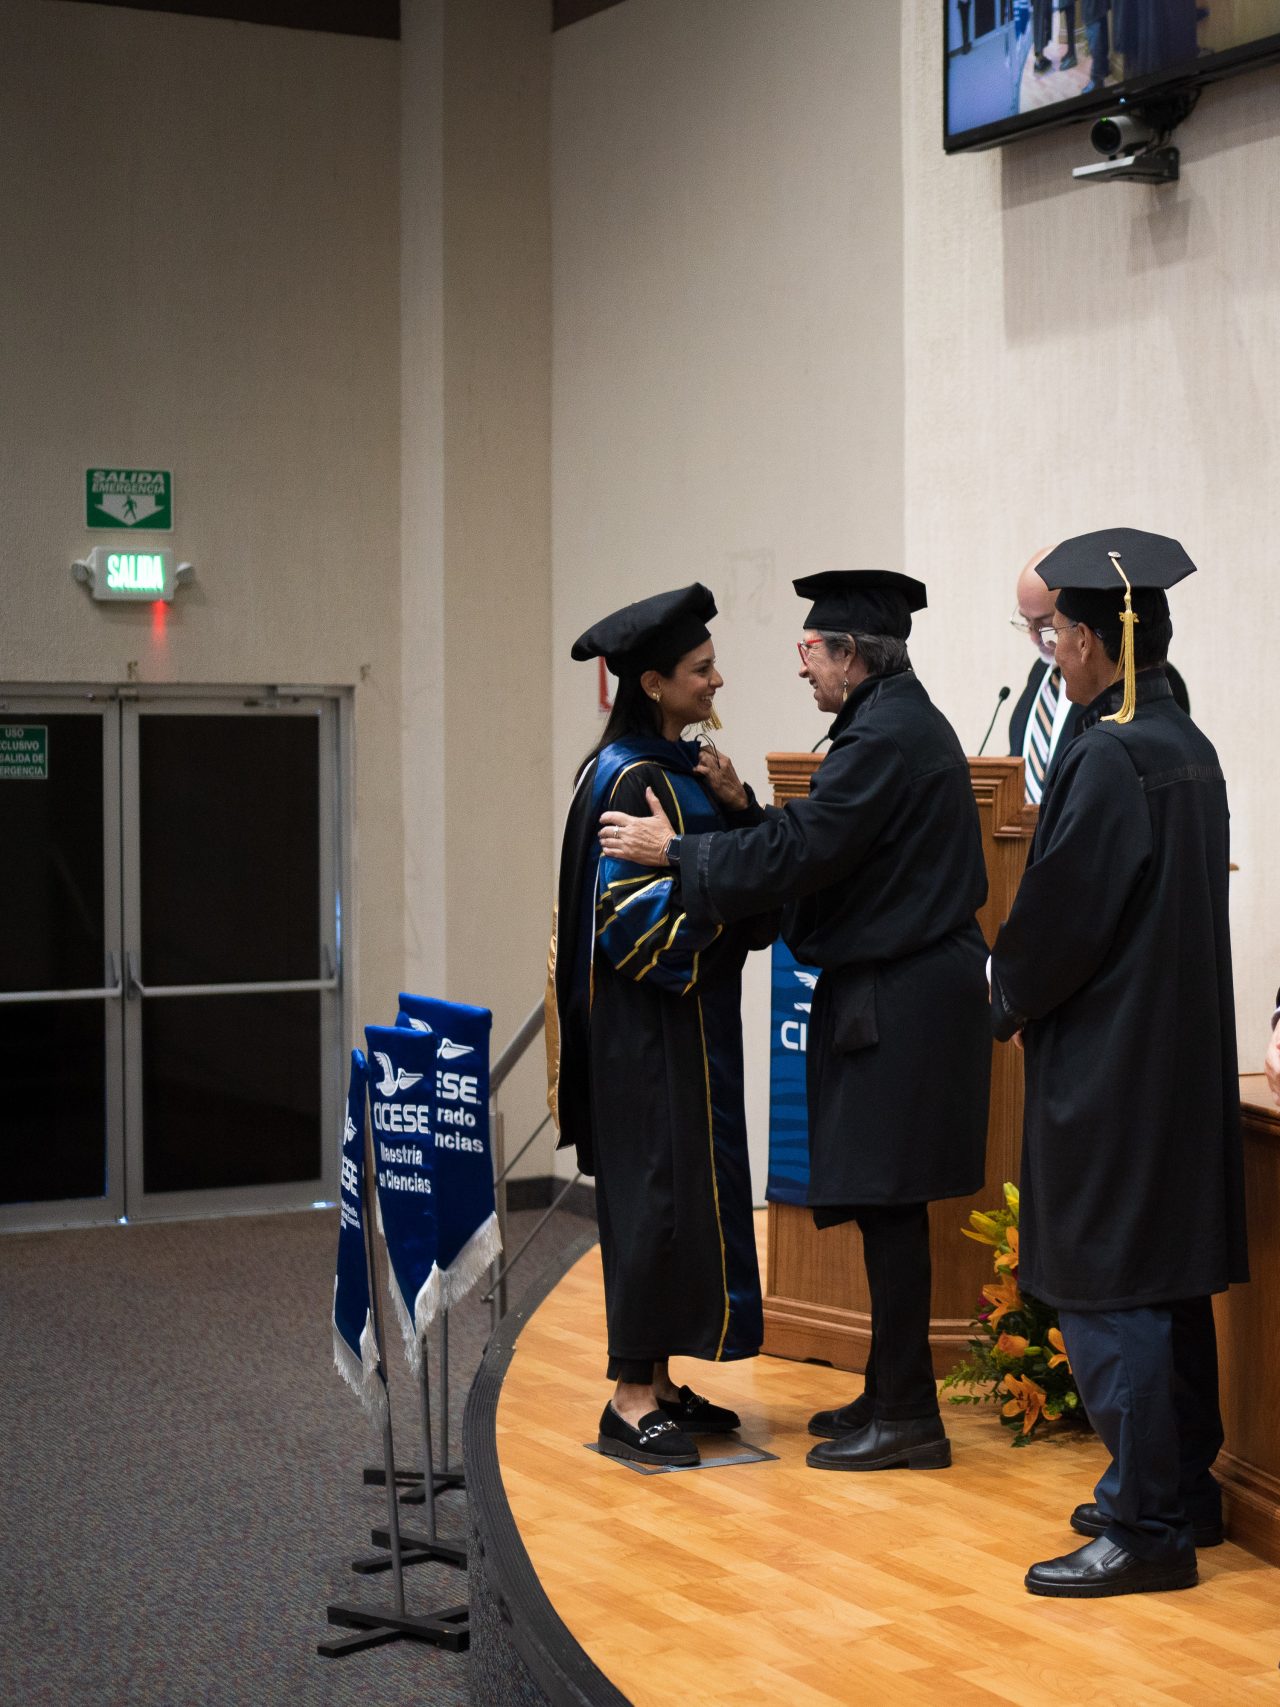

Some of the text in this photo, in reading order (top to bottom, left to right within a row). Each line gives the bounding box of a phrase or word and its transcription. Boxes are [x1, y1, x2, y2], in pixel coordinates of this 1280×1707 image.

[92, 471, 165, 483] SALIDA
[92, 481, 165, 495] EMERGENCIA
[107, 554, 164, 592] SALIDA
[5, 728, 24, 738] USO
[0, 740, 40, 751] CLUSIVO
[32, 752, 44, 764] DE
[0, 765, 43, 777] ERGENCIA
[780, 1020, 807, 1051] CI
[437, 1107, 476, 1127] rado
[434, 1131, 484, 1153] ncias
